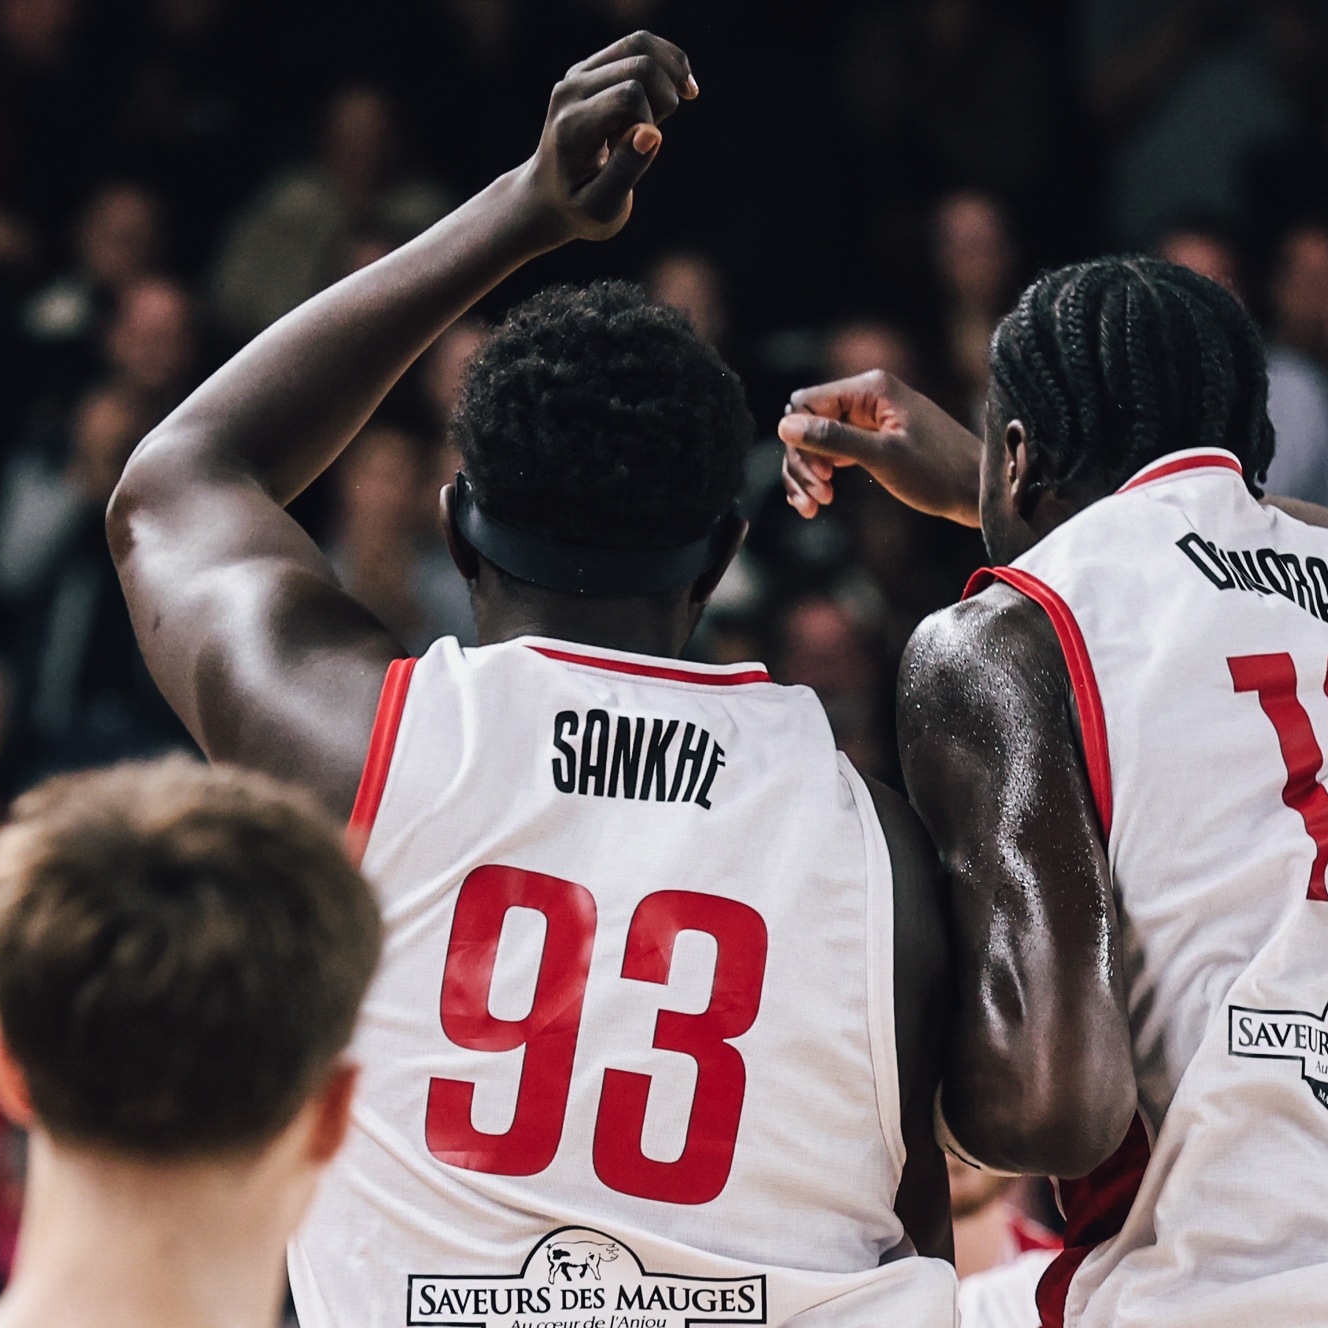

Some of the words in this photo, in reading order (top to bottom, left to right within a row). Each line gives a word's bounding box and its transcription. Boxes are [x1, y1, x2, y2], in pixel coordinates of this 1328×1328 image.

[551, 708, 726, 811] SANKHE
[424, 863, 769, 1206] 93
[1314, 1059, 1328, 1076] Au
[418, 1284, 552, 1316] SAVEURS
[560, 1287, 606, 1311] DES
[614, 1283, 756, 1315] MAUGES
